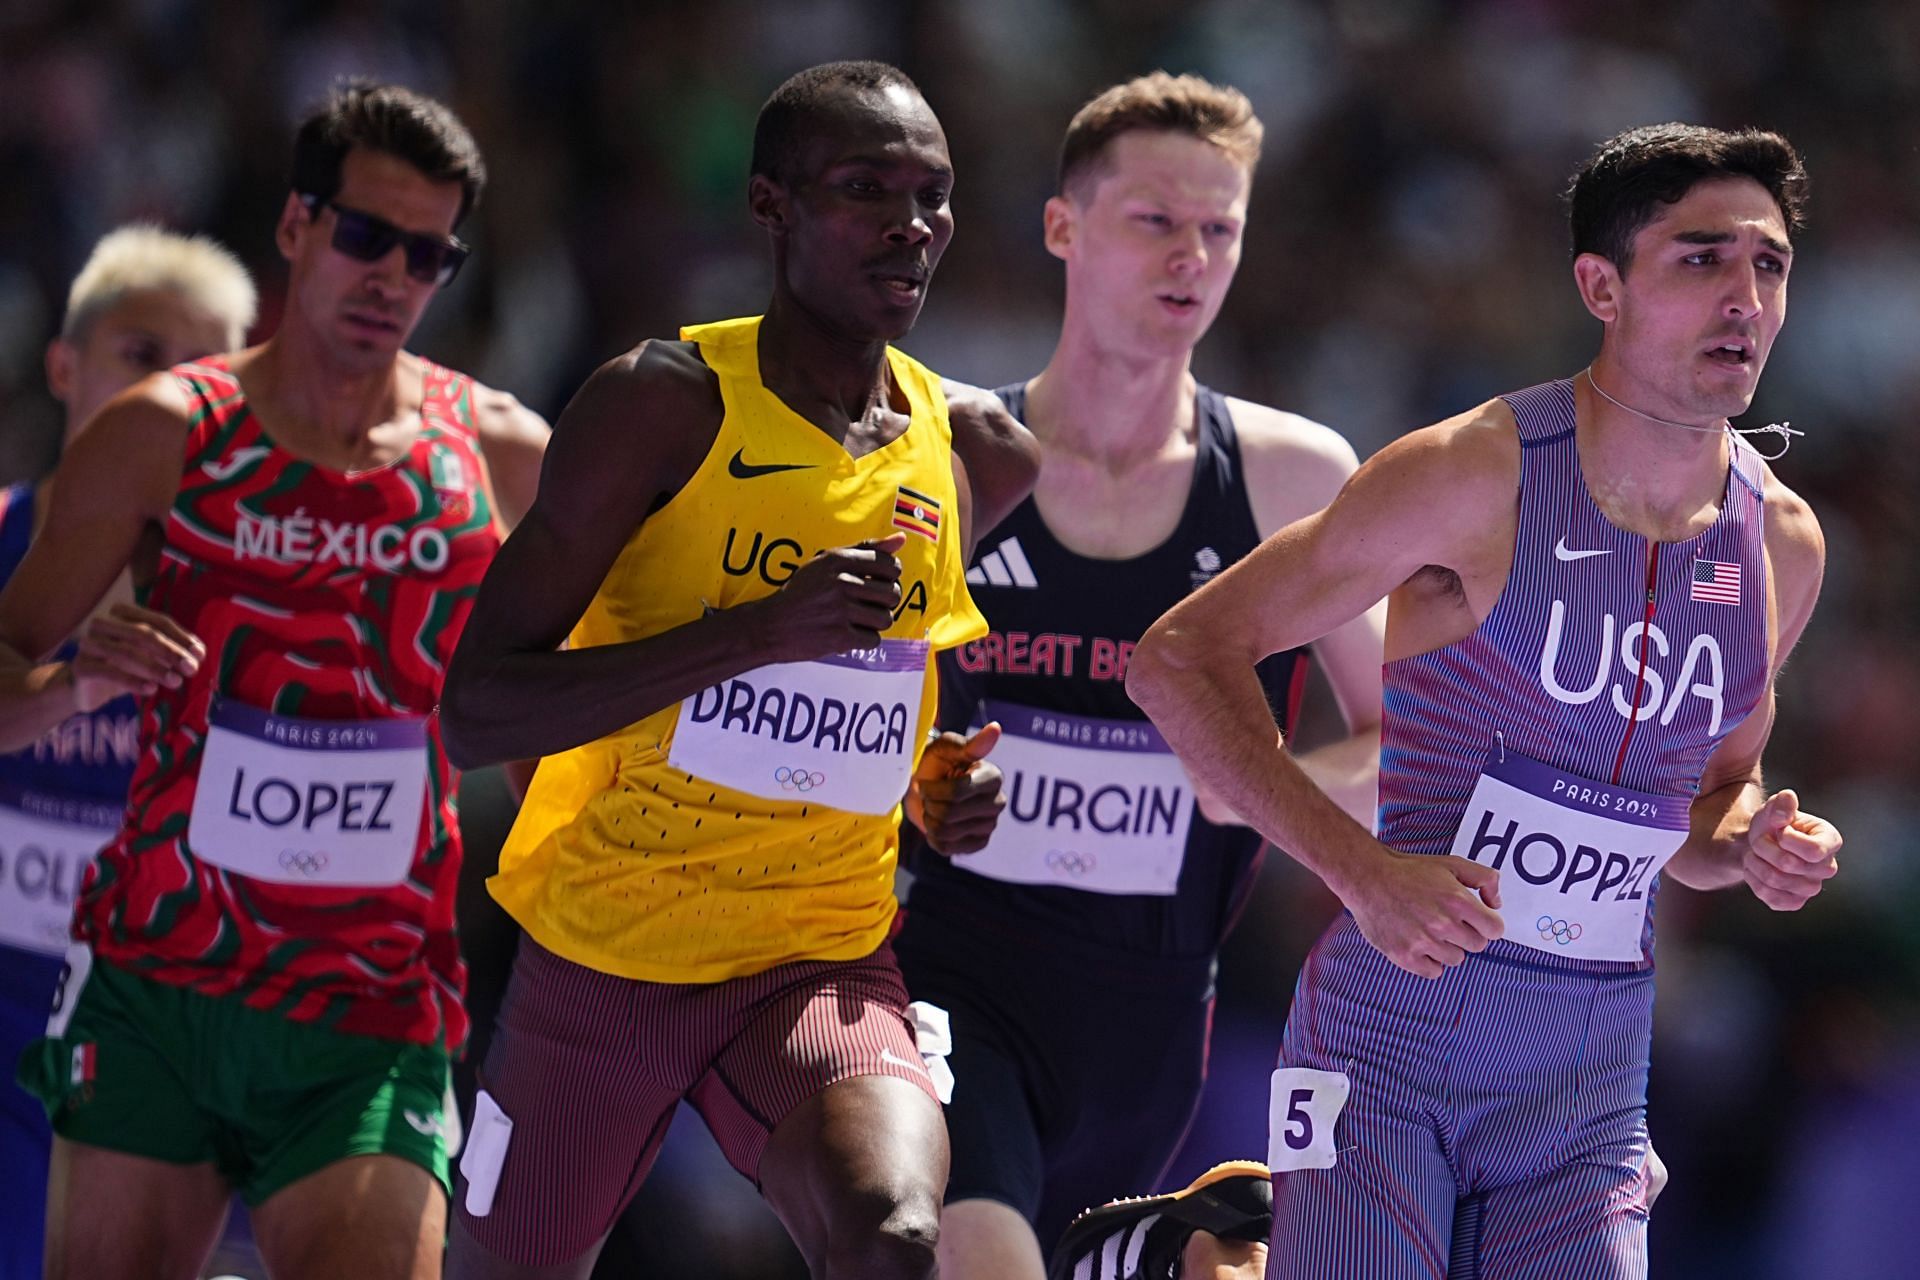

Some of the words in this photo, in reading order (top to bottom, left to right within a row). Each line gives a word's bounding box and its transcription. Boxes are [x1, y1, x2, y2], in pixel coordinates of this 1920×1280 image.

[234, 506, 449, 573] MÉXICO
[722, 527, 928, 622] UGA
[956, 630, 1083, 677] GREAT
[1540, 600, 1724, 737] USA
[264, 719, 321, 744] PARIS
[327, 728, 378, 745] 2024
[690, 679, 908, 755] DRADRIGA
[1031, 716, 1092, 743] PARIS
[1097, 726, 1149, 747] 2024
[228, 766, 396, 833] LOPEZ
[1010, 771, 1182, 835] URGIN
[1552, 779, 1610, 807] PARIS
[1614, 797, 1658, 818] 2024
[1467, 810, 1656, 902] HOPPEL
[1284, 1088, 1314, 1151] 5
